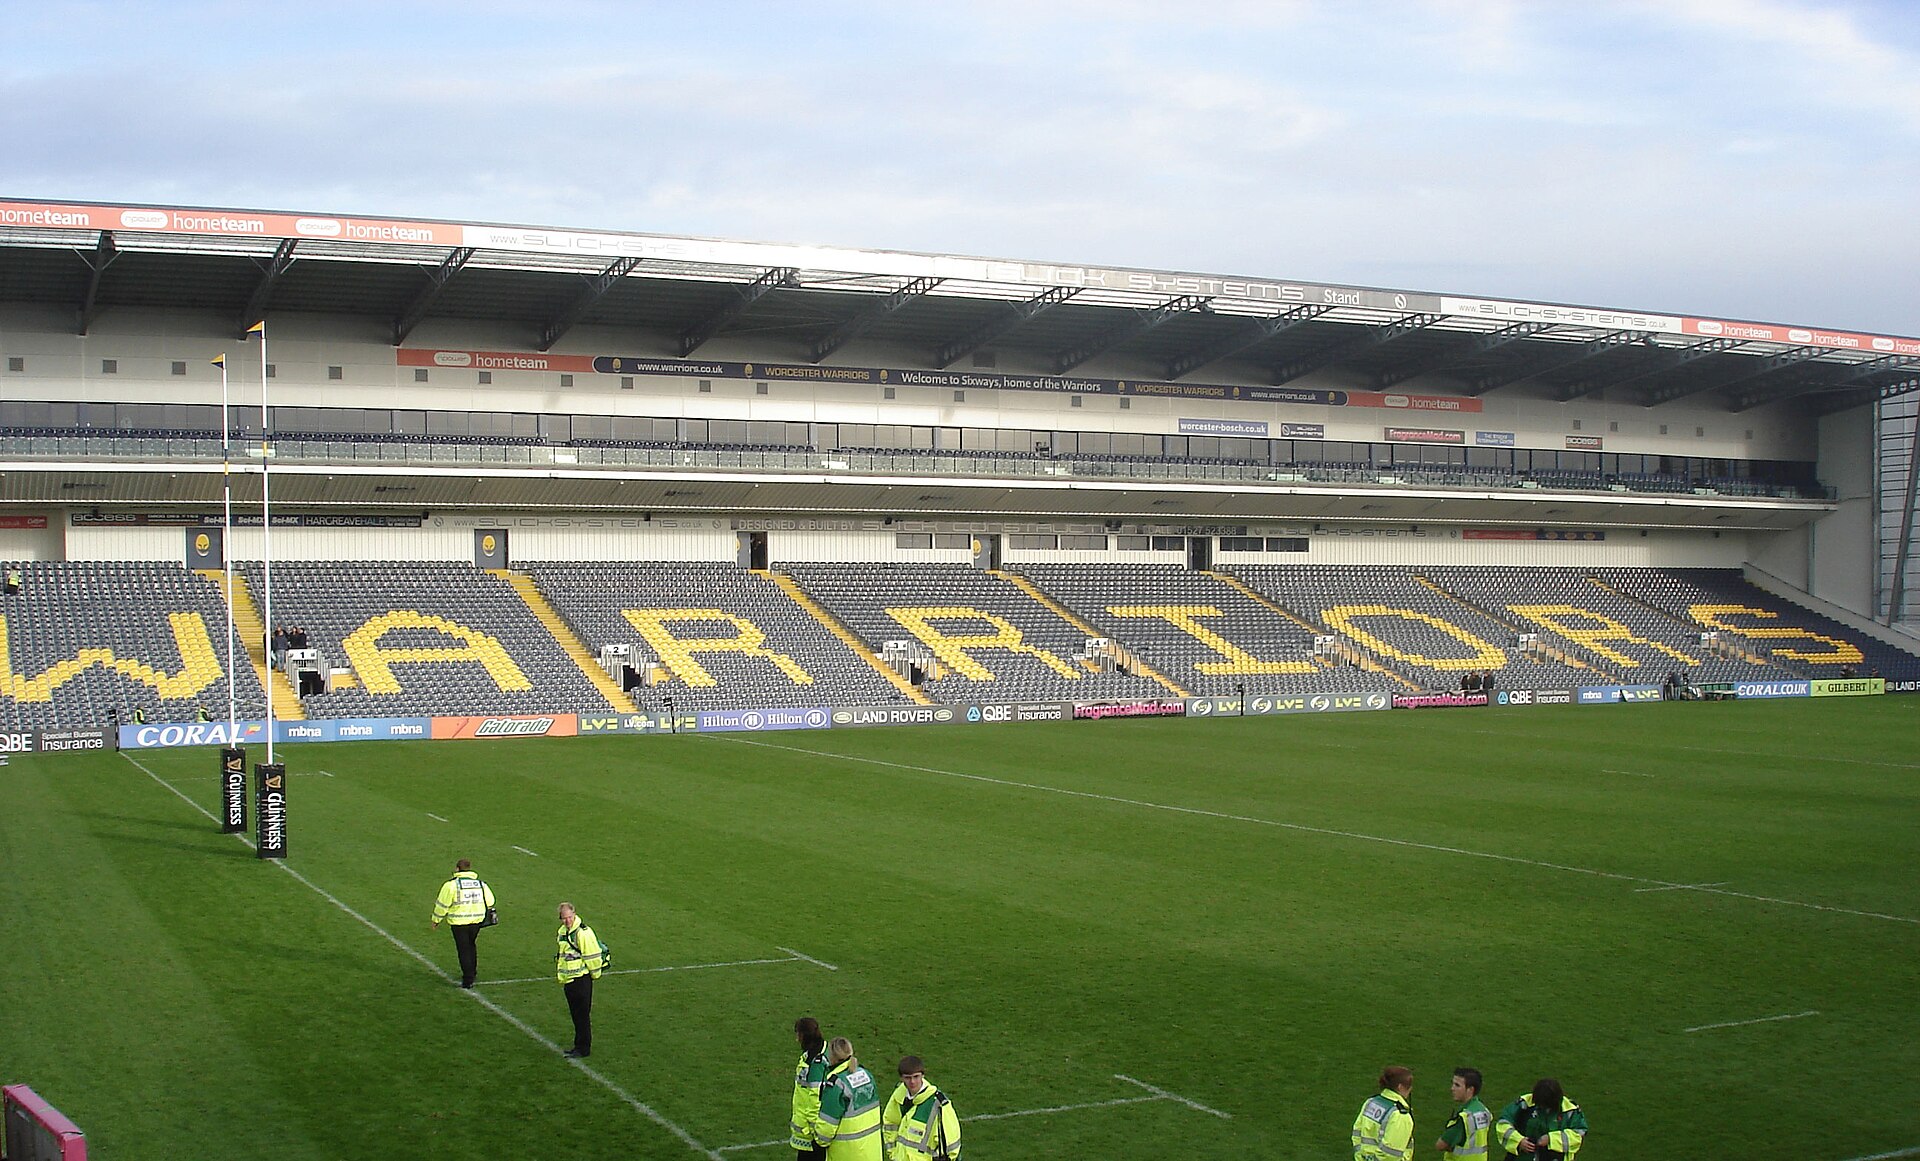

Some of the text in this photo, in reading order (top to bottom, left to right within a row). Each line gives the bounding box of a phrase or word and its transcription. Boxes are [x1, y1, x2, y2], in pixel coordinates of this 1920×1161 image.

[173, 212, 264, 233] hometeam
[346, 220, 433, 242] hometeam
[1128, 273, 1304, 300] SYSTEMS
[1324, 289, 1360, 305] Stand
[1724, 323, 1772, 339] hometeam
[1814, 331, 1859, 348] hometeam
[475, 353, 548, 369] hometeam
[637, 362, 723, 374] www.warriors.co.uk
[764, 367, 870, 380] WORCESTER WARRIORS
[901, 372, 1101, 392] Welcome to Sixways, home of the Warriors
[1135, 383, 1225, 397] WORCESTER WARRIORS
[1411, 396, 1460, 410] hometeam
[1180, 422, 1267, 434] worcester-bosch.co.uk
[738, 519, 796, 530] DESIGNED
[808, 520, 840, 531] BUILT
[841, 520, 855, 531] BY
[1828, 682, 1866, 693] GILBERT
[1895, 681, 1915, 691] LAND
[1392, 691, 1488, 709] FragranceMad.com
[1509, 689, 1533, 704] QBE
[1582, 690, 1602, 699] mbna
[853, 710, 888, 724] LAND
[890, 709, 933, 723] ROVER
[982, 705, 1012, 721] QBE
[1017, 709, 1062, 720] Insurance
[1074, 700, 1184, 720] FragranceMad.com
[624, 717, 655, 728] LV.com
[703, 713, 739, 727] Hilton
[767, 712, 803, 725] Hilton
[288, 725, 322, 738] mbna
[340, 724, 373, 737] mbna
[390, 723, 423, 736] mbna
[478, 718, 551, 735] Gatorade
[137, 724, 245, 747] CORAL
[0, 734, 33, 752] QBE
[41, 738, 103, 751] Insurance
[229, 773, 242, 825] GUINNESS
[267, 792, 282, 850] GUINNESS
